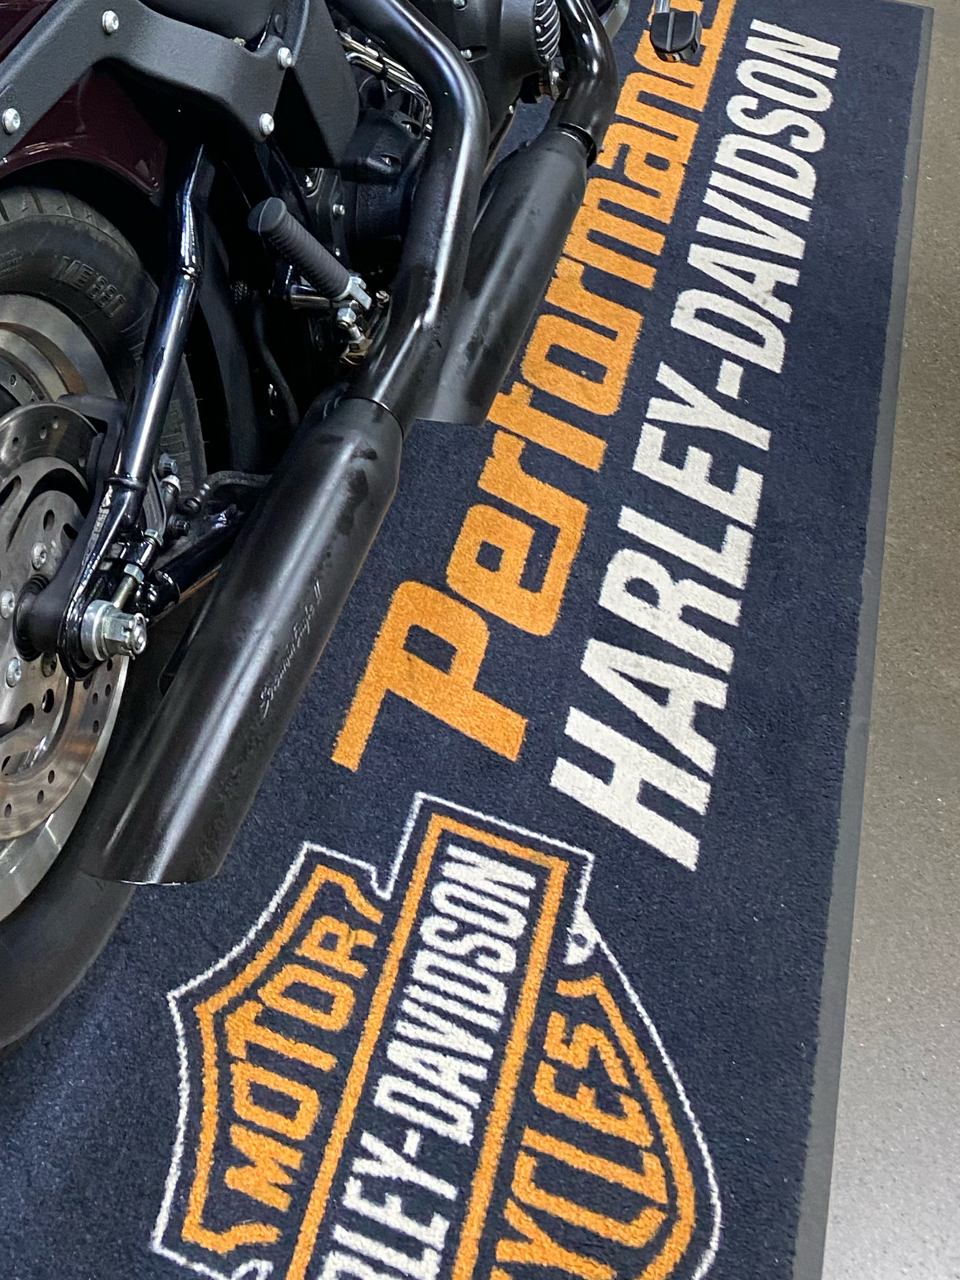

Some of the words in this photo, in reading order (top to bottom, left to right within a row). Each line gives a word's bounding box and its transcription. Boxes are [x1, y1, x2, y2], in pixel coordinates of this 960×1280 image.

[549, 20, 841, 872] HARLEY-DAVIDSON
[224, 915, 378, 1213] MOTOR
[490, 1010, 669, 1280] YCLES
